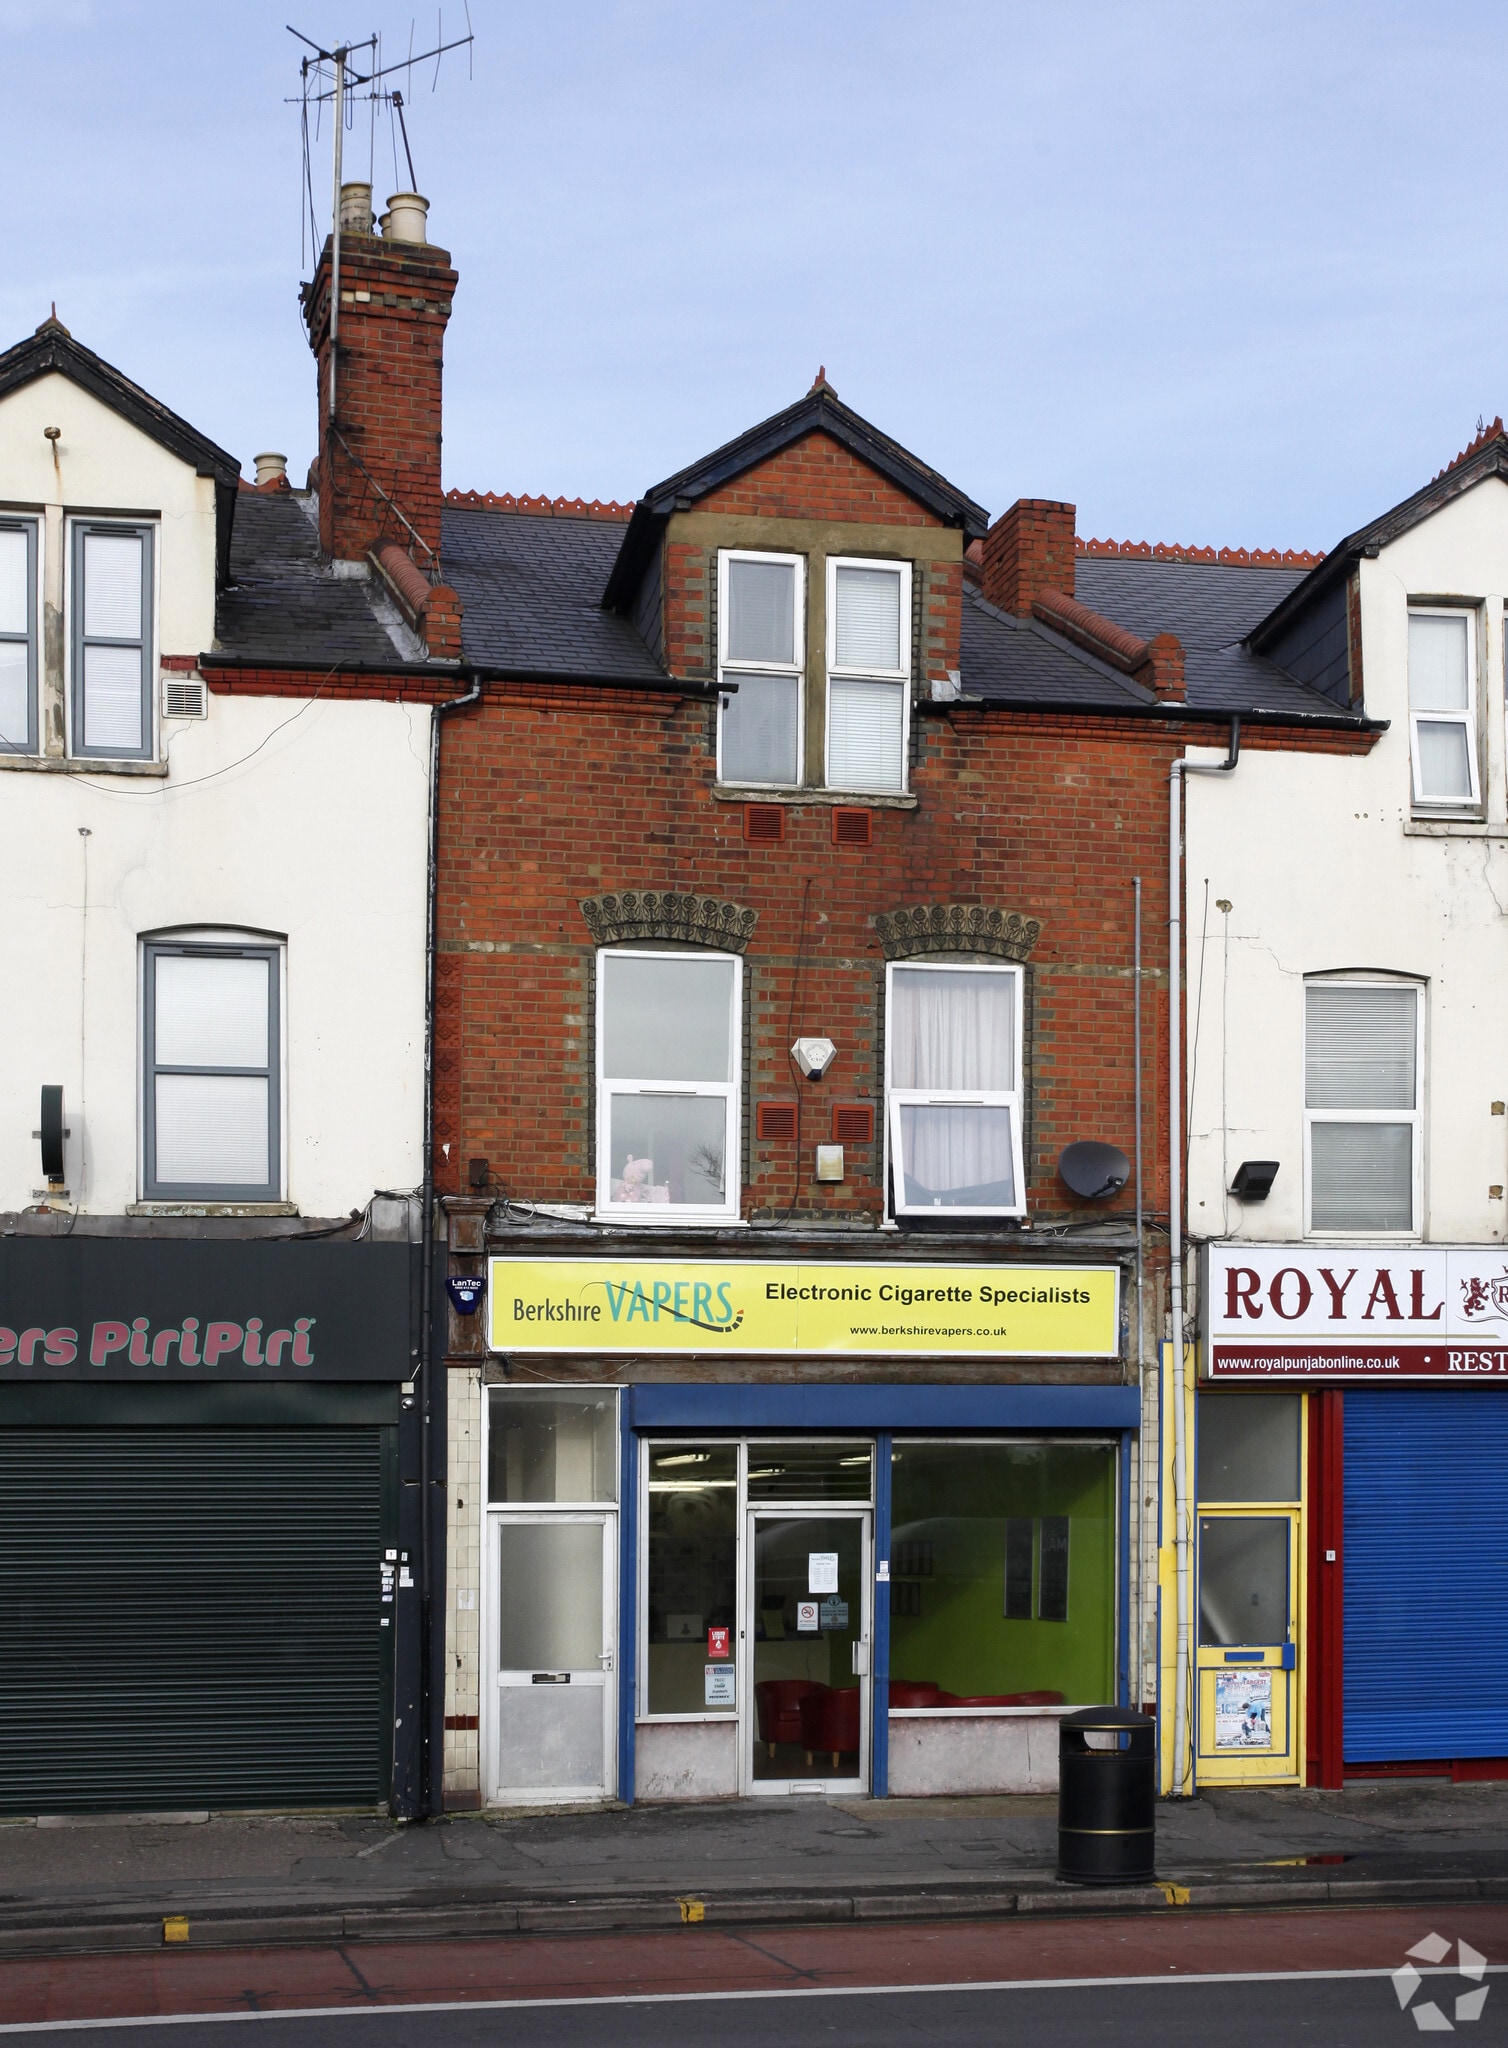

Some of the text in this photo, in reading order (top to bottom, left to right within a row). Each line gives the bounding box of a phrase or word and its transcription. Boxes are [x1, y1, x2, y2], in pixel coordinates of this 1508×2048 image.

[514, 1280, 733, 1324] Berkshire VAPERS
[765, 1283, 1091, 1307] Electronic Cigarette Specialists
[1222, 1267, 1446, 1320] ROYAL
[849, 1325, 1007, 1338] www.berkshirevapers.co.uk
[1217, 1351, 1508, 1372] www.royalpunjabonline.co.uk REST
